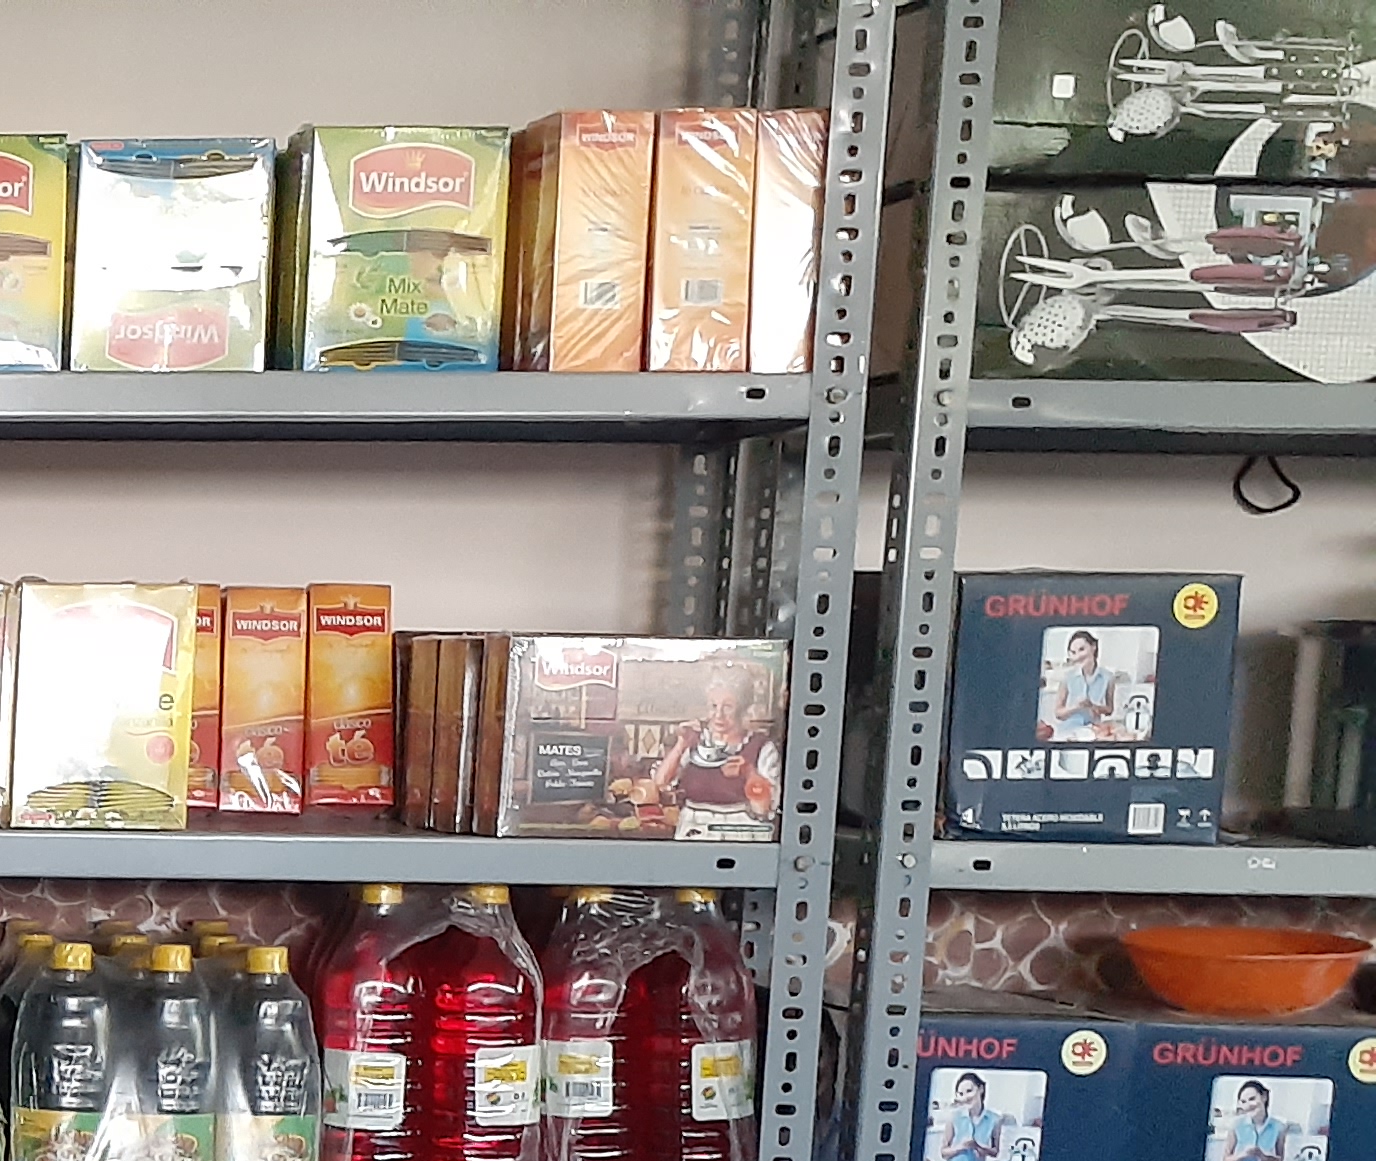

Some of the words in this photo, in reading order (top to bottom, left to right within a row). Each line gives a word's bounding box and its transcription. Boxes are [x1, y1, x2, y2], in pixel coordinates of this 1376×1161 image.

[359, 171, 466, 193] Windsor
[388, 278, 422, 294] Mix
[380, 299, 428, 315] Mate
[984, 589, 1130, 618] GRÜNHOF
[235, 619, 298, 631] WINDSOR
[319, 615, 382, 627] WINDSOR
[326, 729, 375, 767] té
[538, 744, 582, 756] MATES
[917, 1029, 1018, 1060] ÜNHOF
[1153, 1037, 1304, 1067] GRÜNHOF
